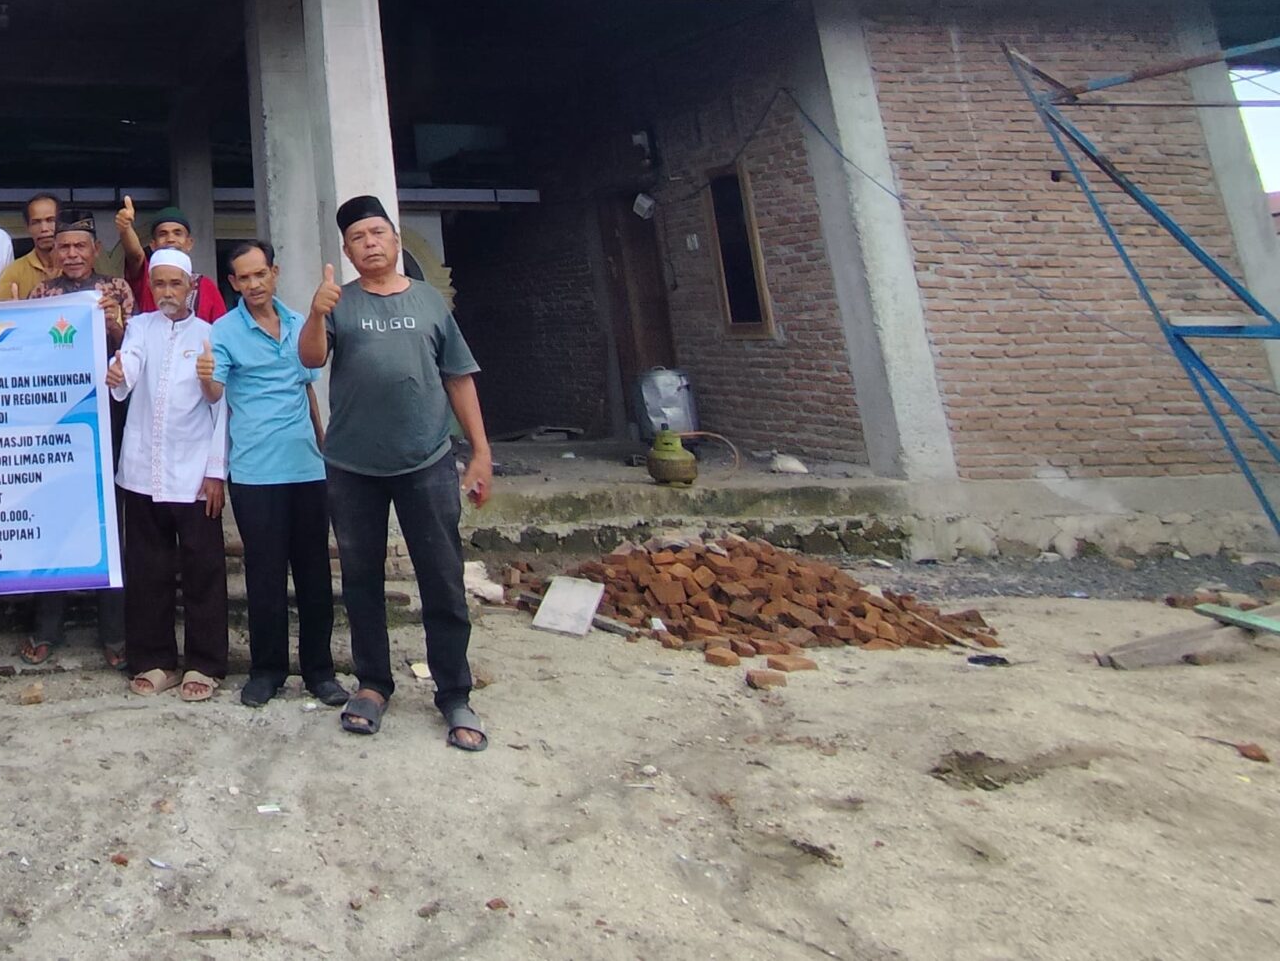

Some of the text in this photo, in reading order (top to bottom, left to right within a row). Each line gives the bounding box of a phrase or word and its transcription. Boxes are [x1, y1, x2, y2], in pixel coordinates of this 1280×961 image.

[361, 316, 416, 333] HUGO
[10, 376, 31, 388] DAN
[31, 373, 92, 387] LINGKUNGAN
[0, 394, 12, 406] IV
[12, 392, 59, 405] REGIONAL
[59, 391, 68, 403] II
[34, 434, 72, 446] TAQWA
[13, 453, 46, 466] LIMAG
[46, 452, 75, 464] RAYA
